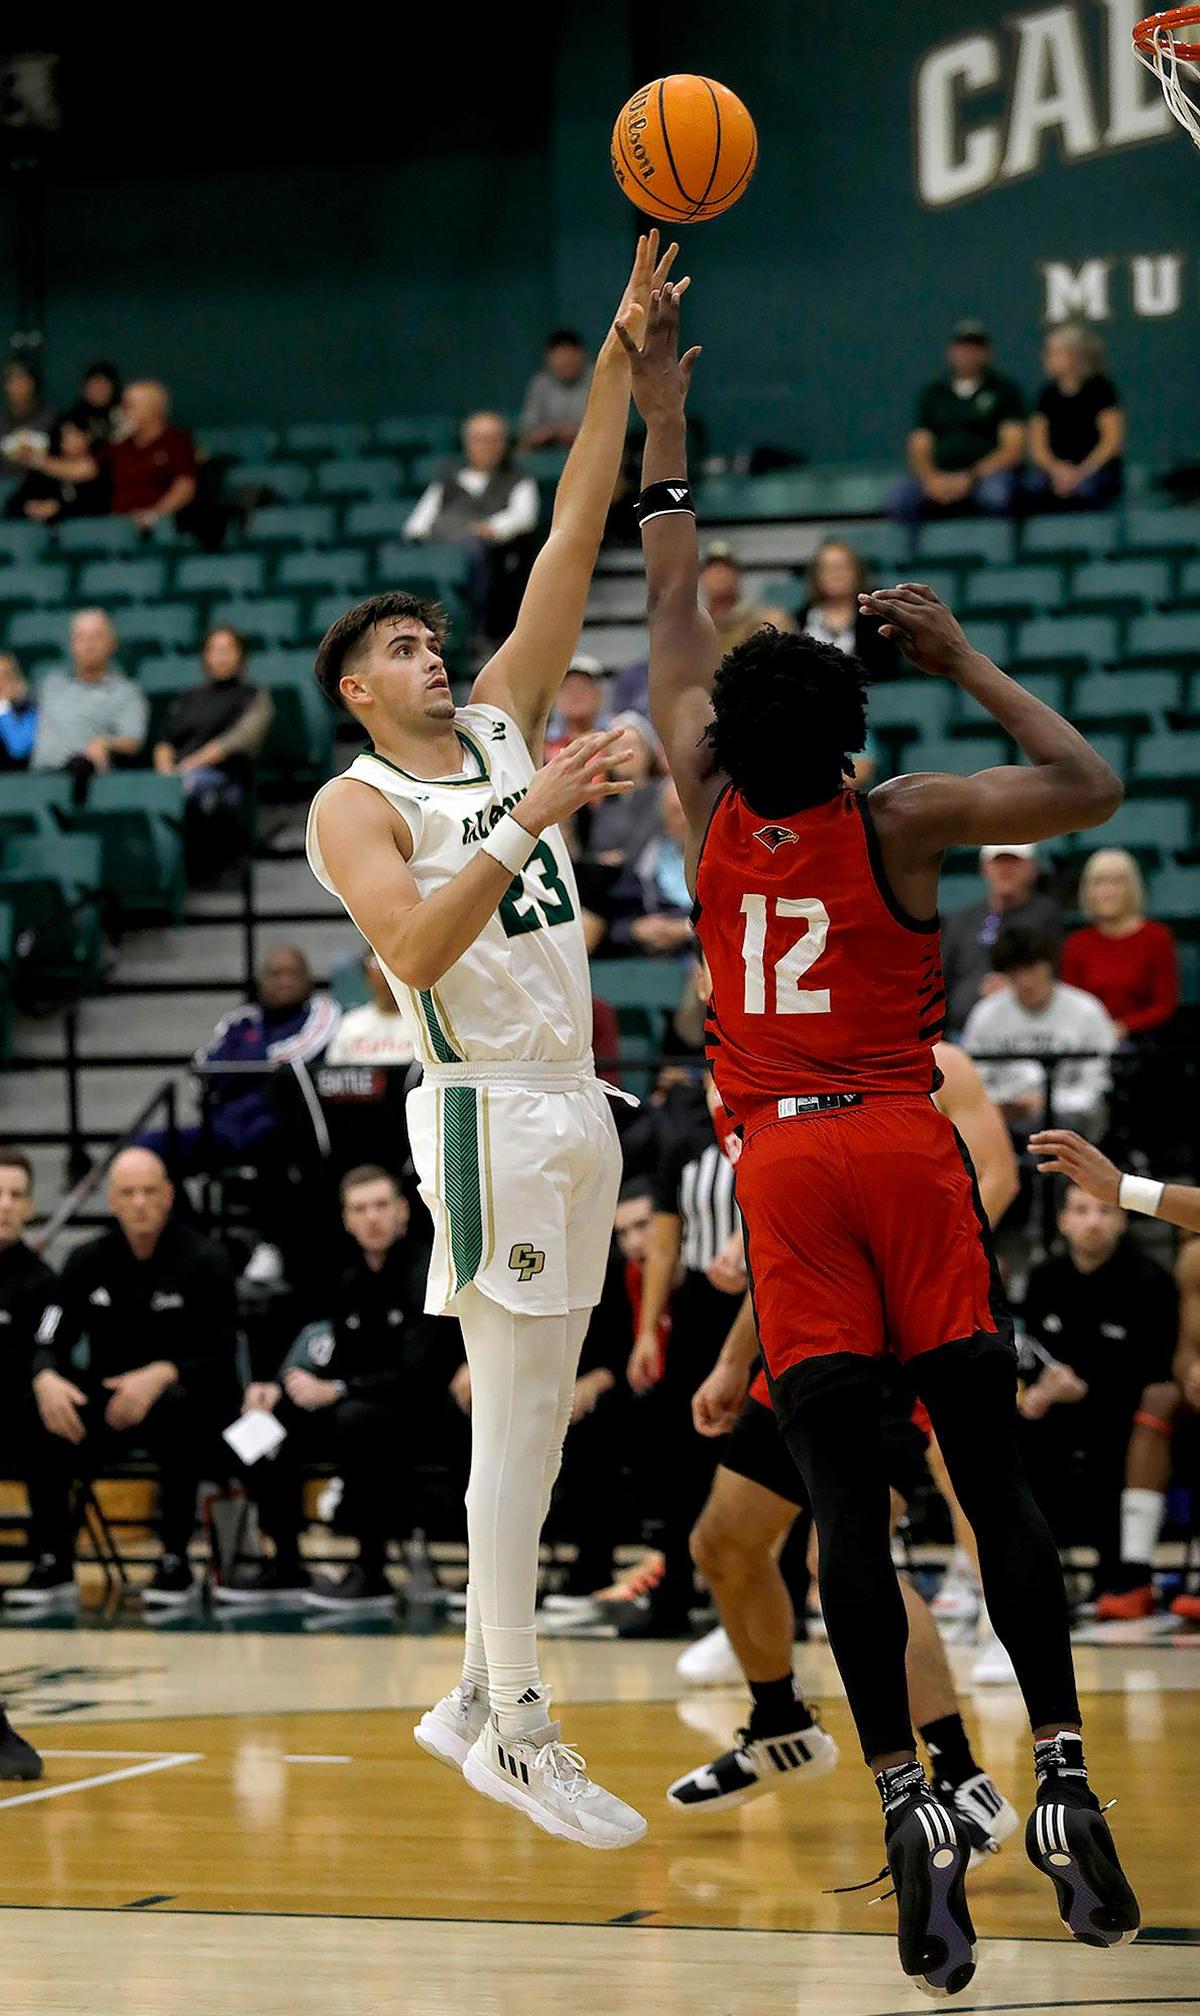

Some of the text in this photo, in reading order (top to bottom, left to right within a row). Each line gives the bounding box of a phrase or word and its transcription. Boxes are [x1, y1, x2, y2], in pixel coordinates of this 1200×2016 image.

[628, 84, 656, 182] Wilson
[916, 0, 1178, 206] CAL
[499, 838, 575, 938] 23
[739, 893, 831, 1014] 12
